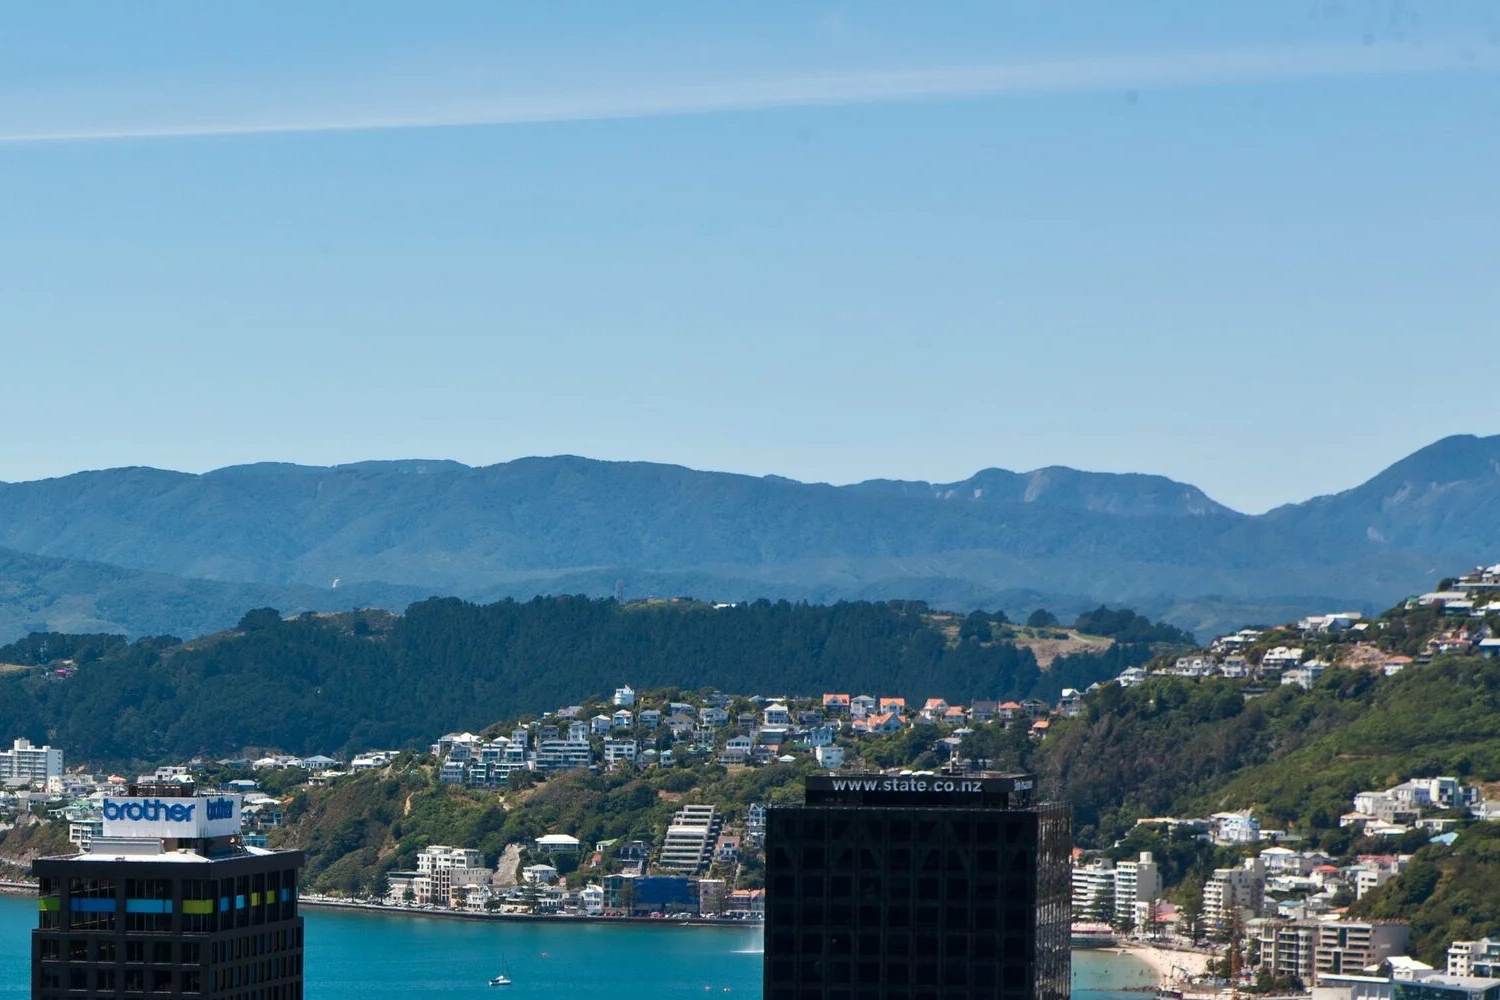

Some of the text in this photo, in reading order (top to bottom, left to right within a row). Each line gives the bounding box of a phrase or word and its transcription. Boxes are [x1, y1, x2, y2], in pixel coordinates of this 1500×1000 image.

[832, 778, 982, 793] www.state.co.nz
[103, 798, 195, 822] brother
[206, 797, 234, 821] brother
